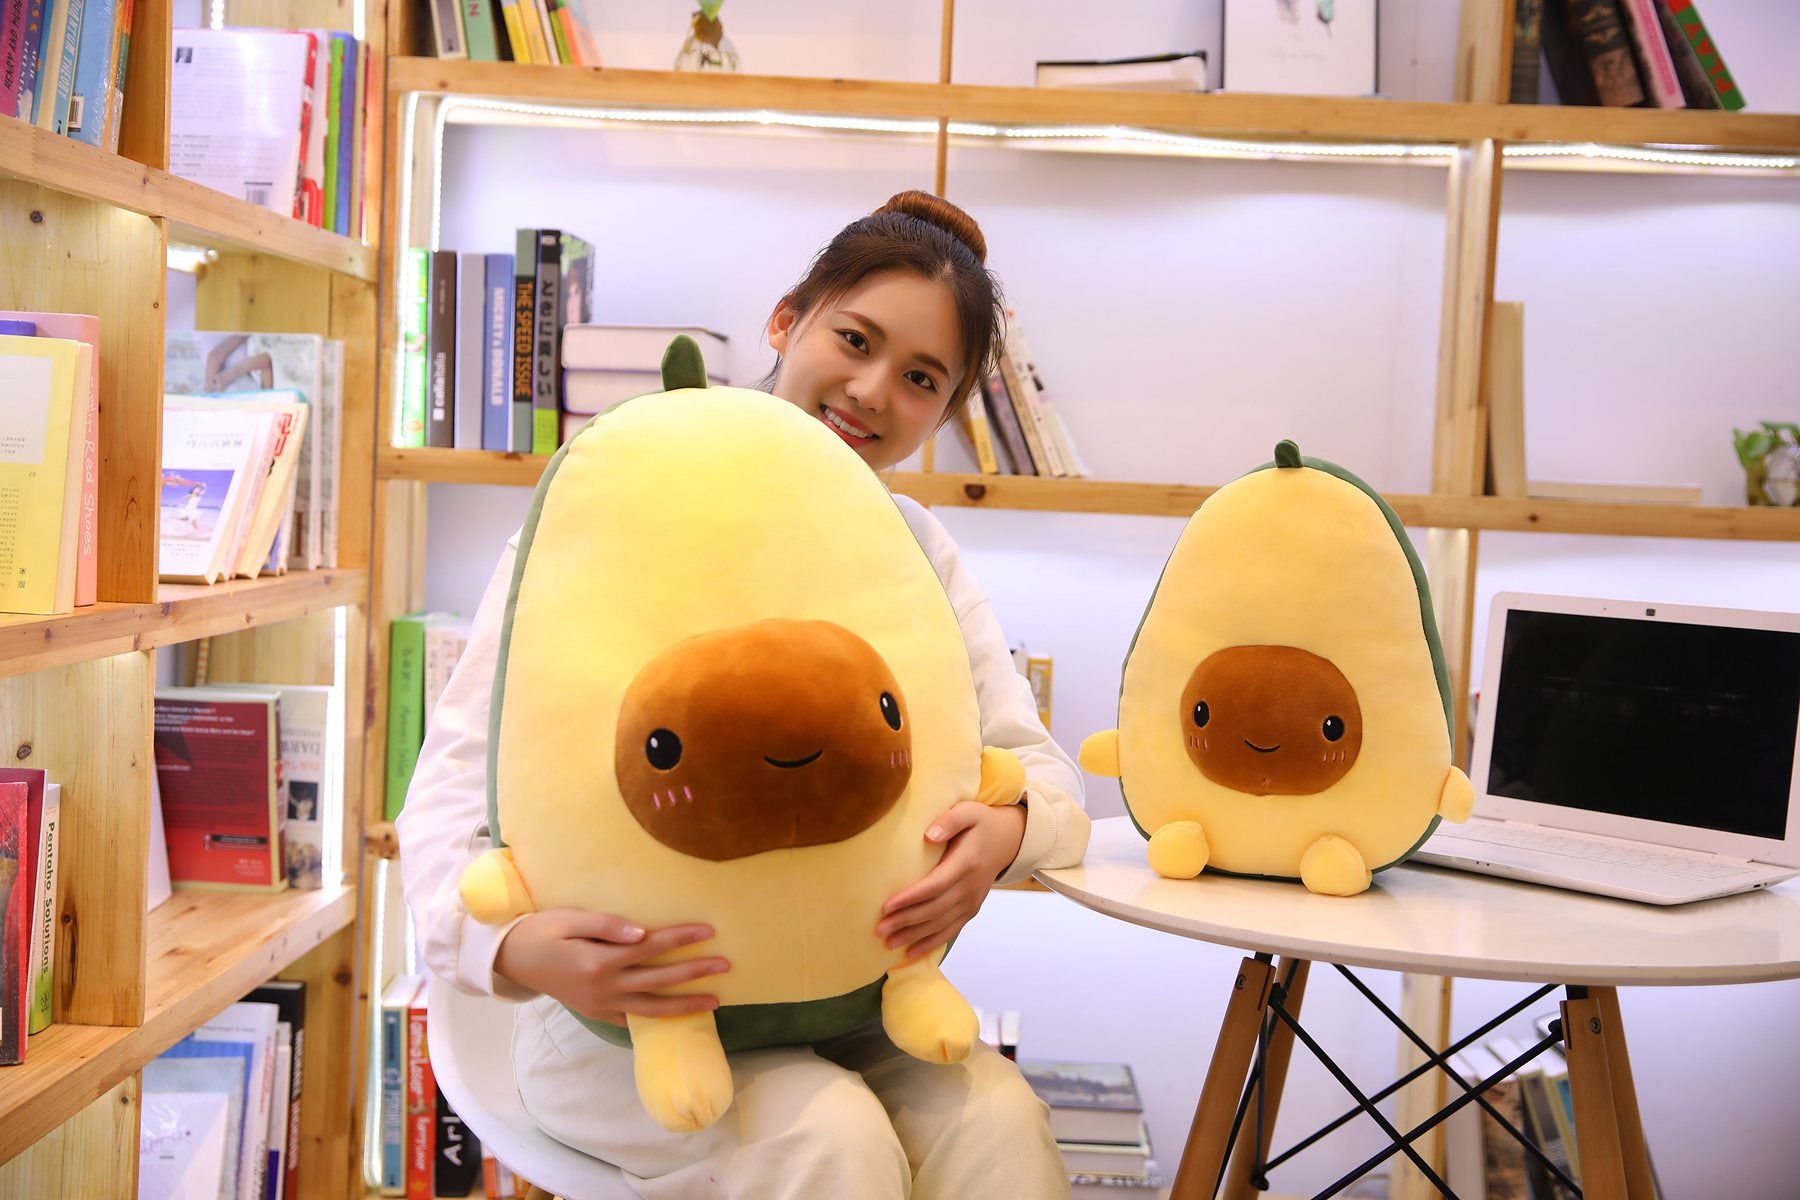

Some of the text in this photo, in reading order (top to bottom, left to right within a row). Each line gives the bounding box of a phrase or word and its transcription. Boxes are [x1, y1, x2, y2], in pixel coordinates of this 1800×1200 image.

[4, 53, 14, 91] HENRY
[9, 29, 18, 53] AND
[58, 57, 73, 100] THEORY
[515, 282, 533, 397] THE SPEED ISSUE
[83, 439, 95, 483] Red
[83, 494, 95, 555] Shoes
[46, 822, 55, 890] Pentaho
[44, 898, 53, 974] Solutions
